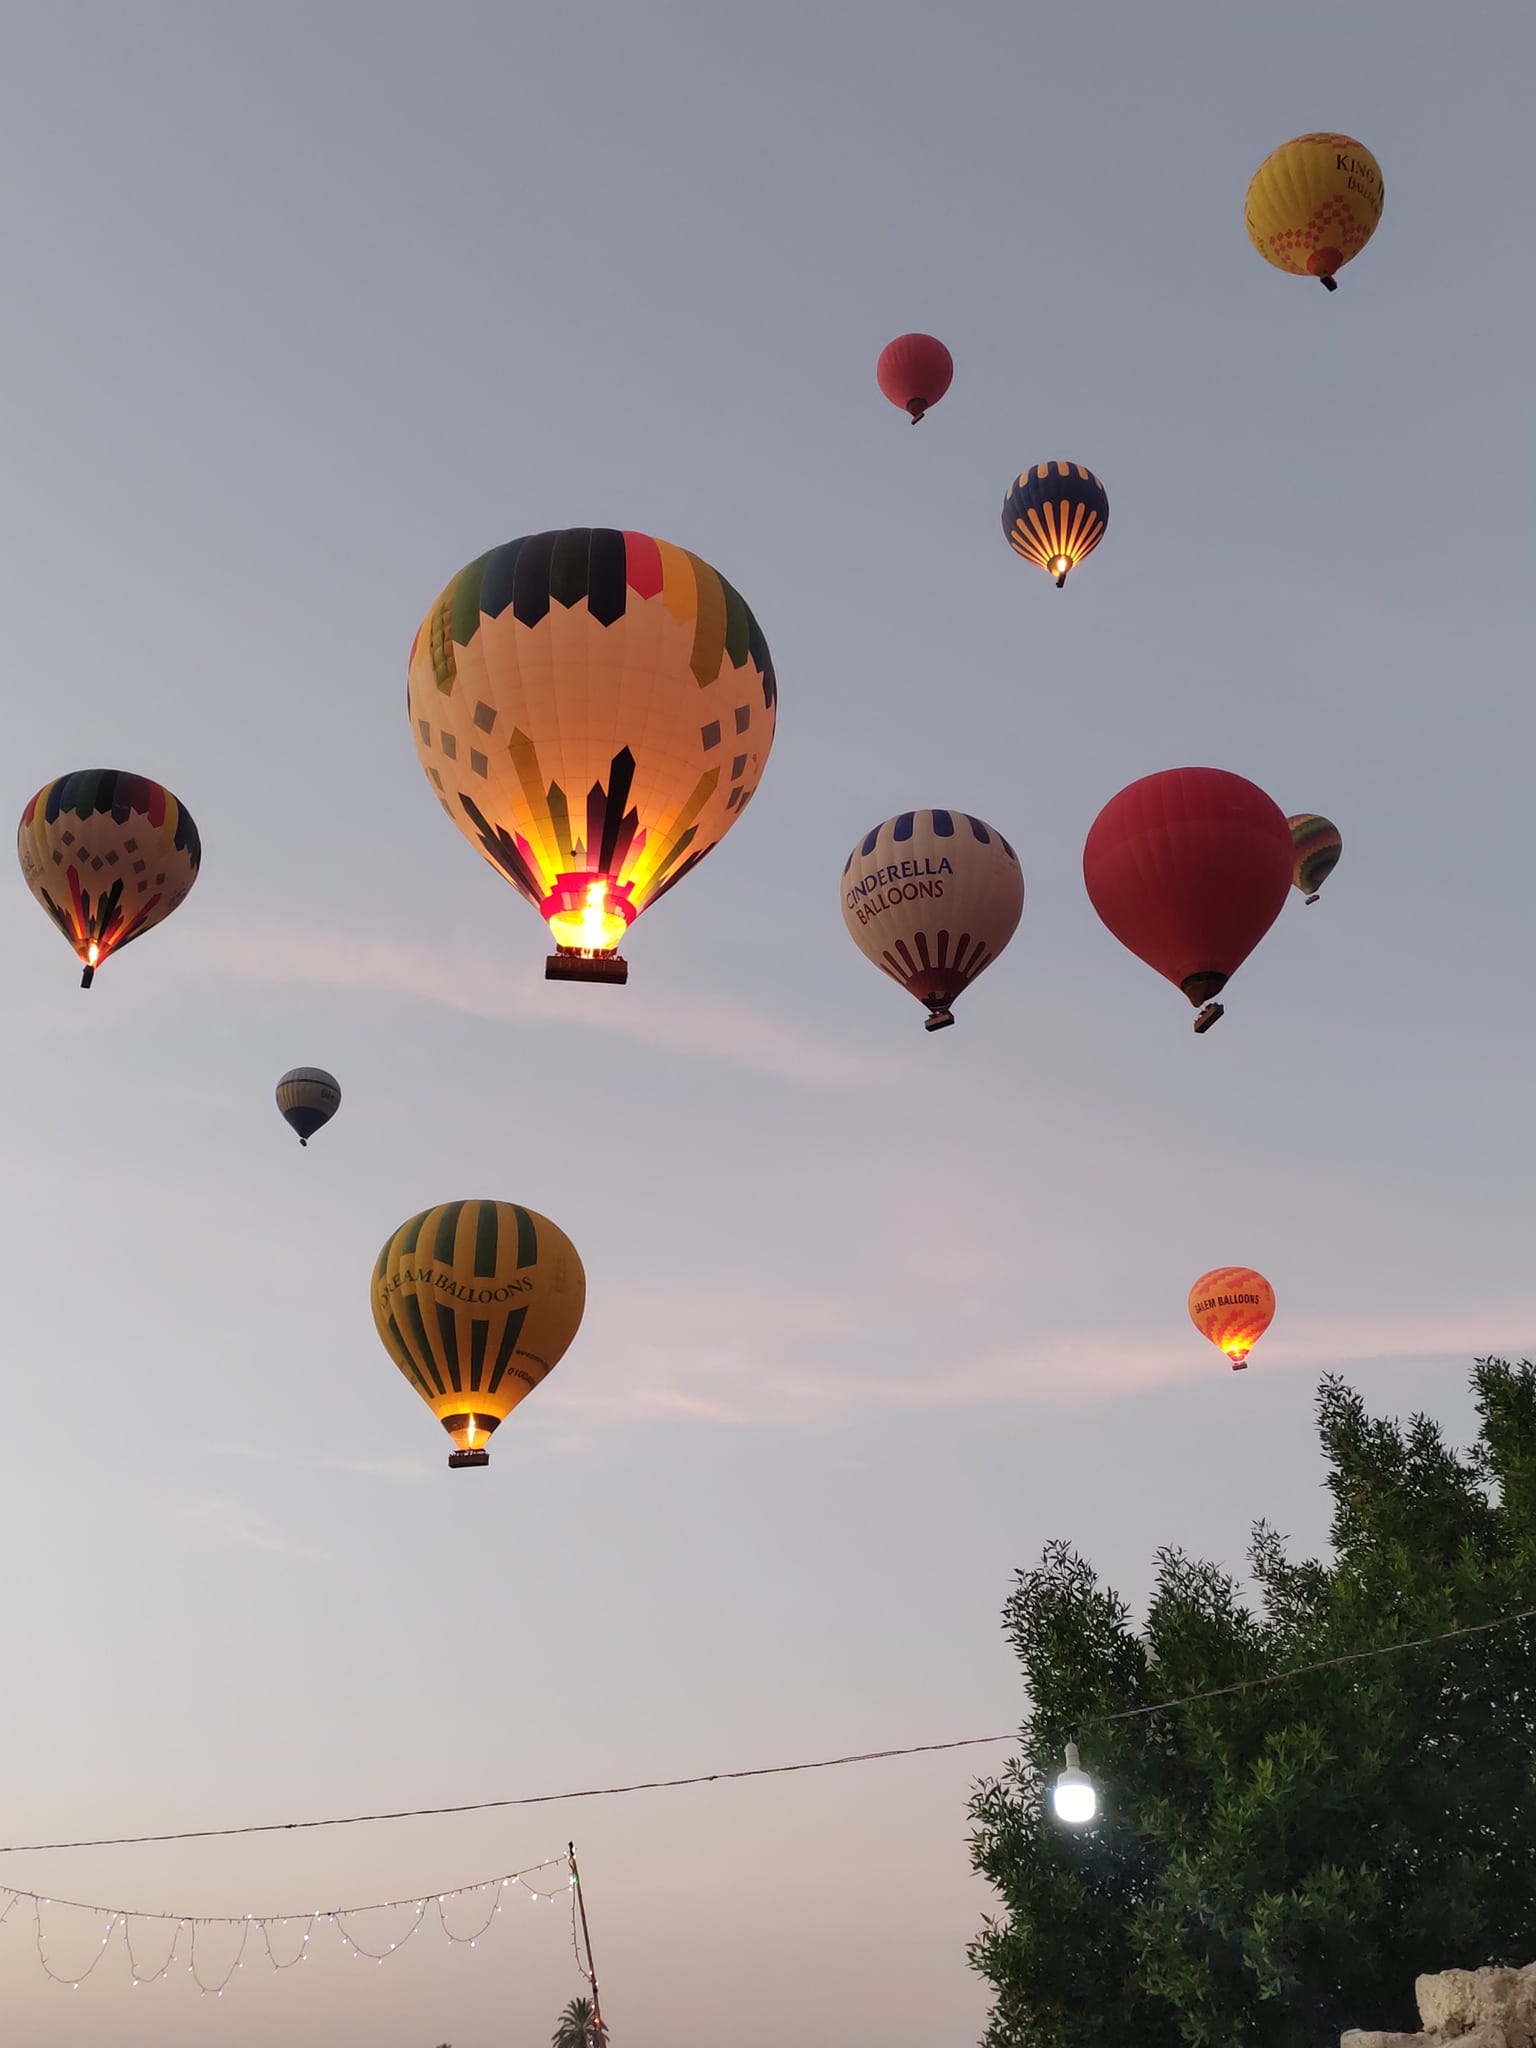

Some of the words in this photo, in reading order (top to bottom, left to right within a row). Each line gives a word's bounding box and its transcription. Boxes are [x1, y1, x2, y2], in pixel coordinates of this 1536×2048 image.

[1336, 154, 1375, 183] KING
[846, 857, 953, 910] CINDERELLA
[856, 879, 943, 925] BALLOONS
[434, 1274, 533, 1304] BALLOONS
[1217, 1294, 1260, 1307] BALLOONS
